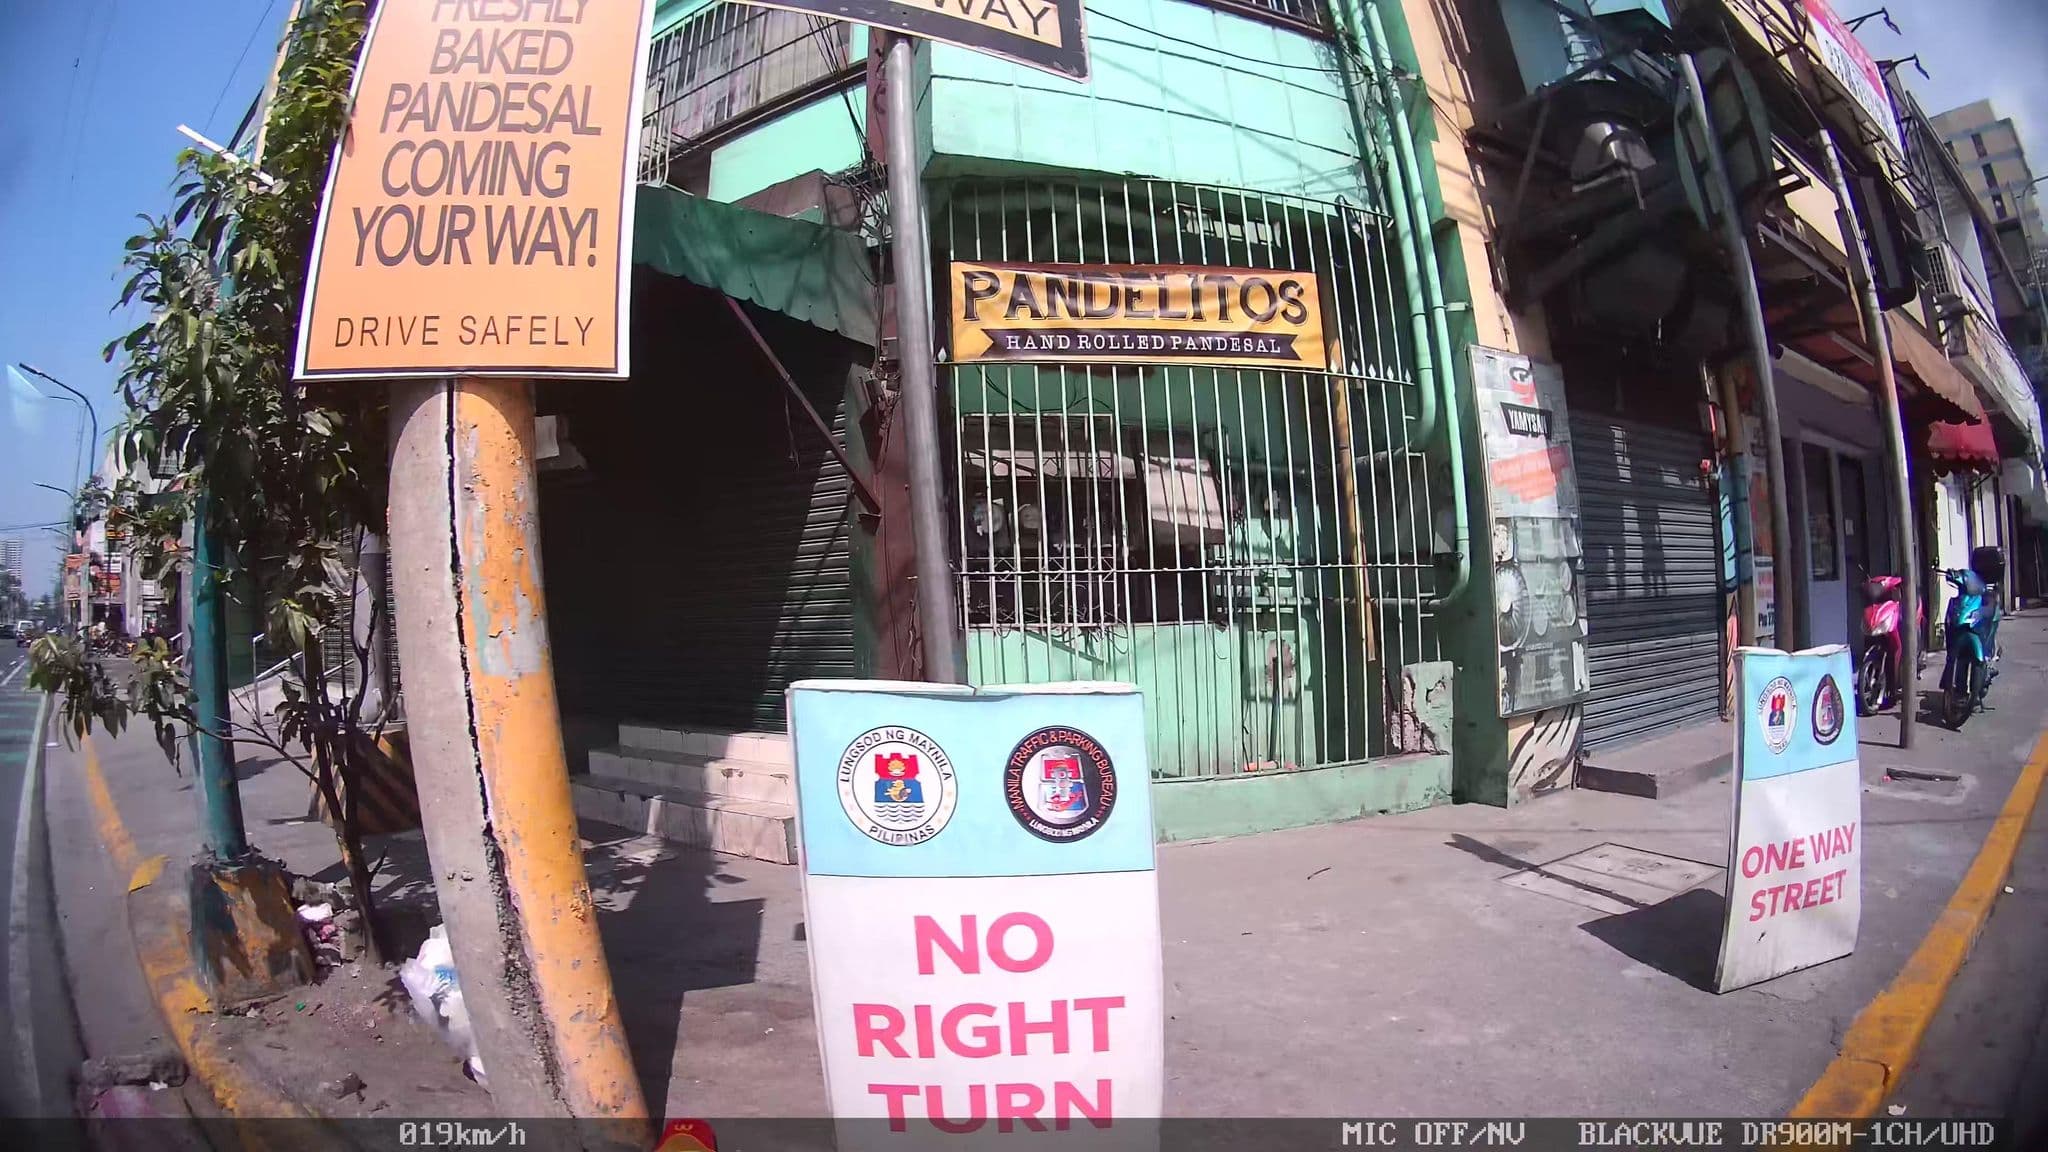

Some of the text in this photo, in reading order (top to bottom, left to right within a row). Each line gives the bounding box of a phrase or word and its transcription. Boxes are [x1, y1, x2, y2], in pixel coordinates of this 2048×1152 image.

[429, 28, 575, 76] BAKED
[379, 81, 602, 136] PANDESAL
[381, 138, 572, 199] COMING
[352, 204, 599, 268] YOUR WAY!
[961, 270, 1308, 327] PANDELITOS
[334, 314, 595, 347] DRIVE SAFELY
[1005, 334, 1282, 354] HAND ROLLED PANDESAL
[840, 730, 953, 783] LUNGSOD NG MAYNILA
[1007, 731, 1114, 810] MANILA TRAFFIC & PARKING BUREAU
[868, 825, 935, 843] PILIPINAS
[1741, 822, 1856, 879] ONE WAY
[1749, 868, 1847, 922] STREET
[913, 911, 1055, 976] NO
[852, 996, 1126, 1059] RIGHT
[867, 1079, 1114, 1134] TURN
